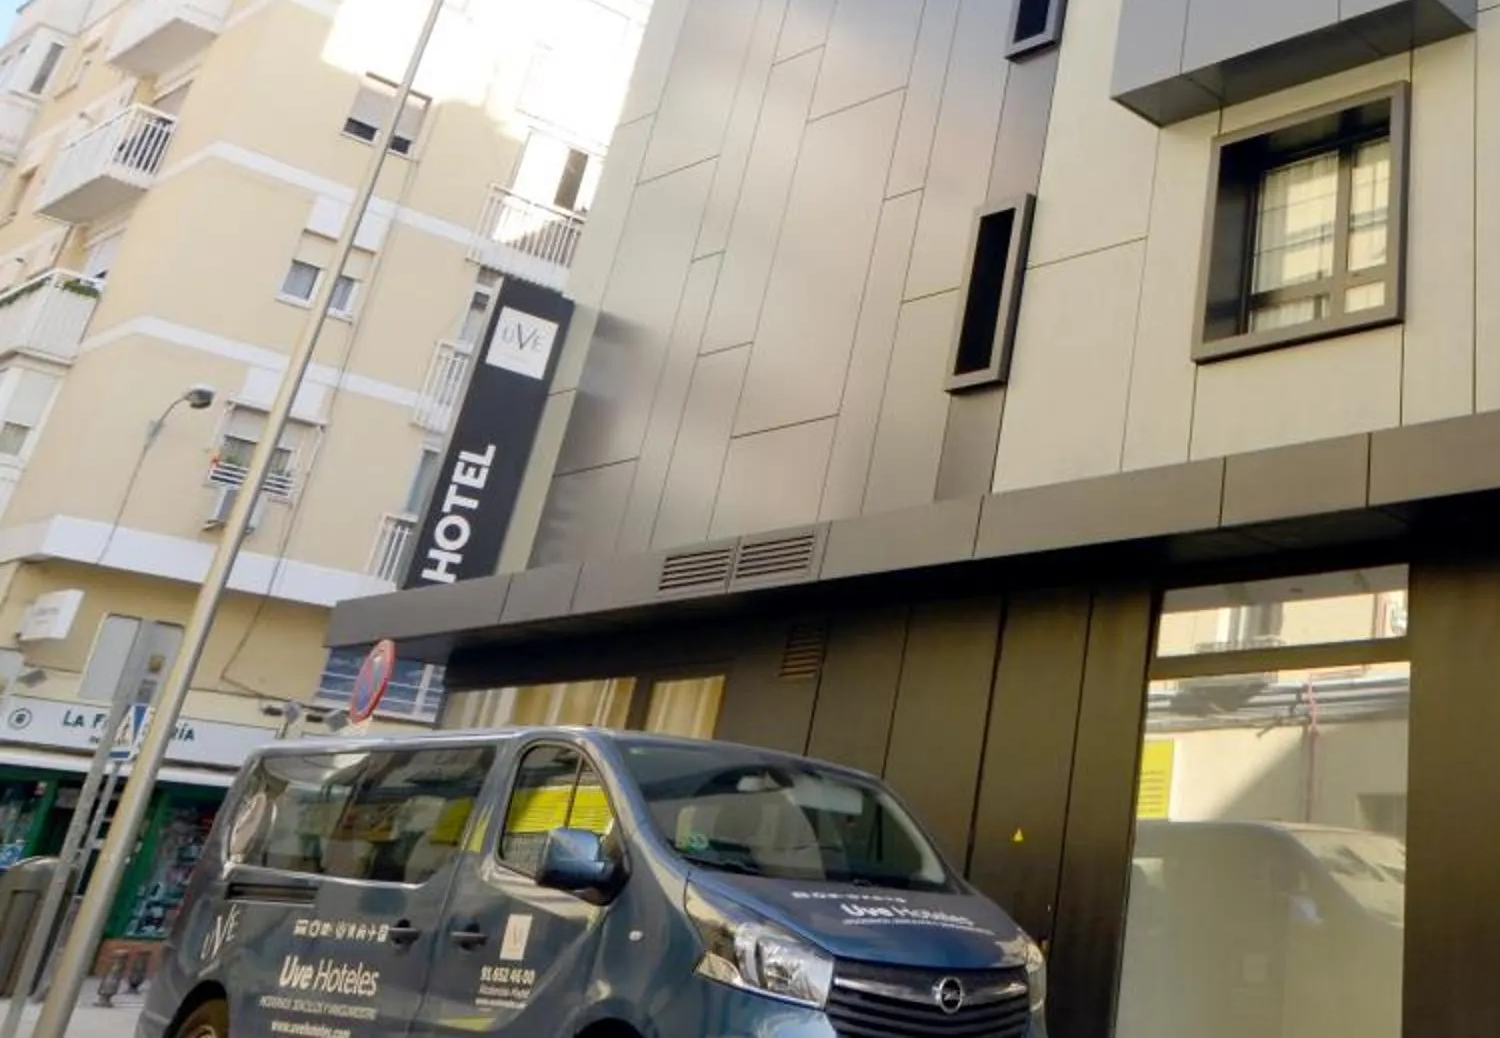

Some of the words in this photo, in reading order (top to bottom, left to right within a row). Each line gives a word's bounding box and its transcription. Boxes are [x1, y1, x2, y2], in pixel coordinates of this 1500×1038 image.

[421, 444, 496, 583] HOTEL
[279, 954, 313, 989] Uve
[312, 959, 380, 997] Hoteles
